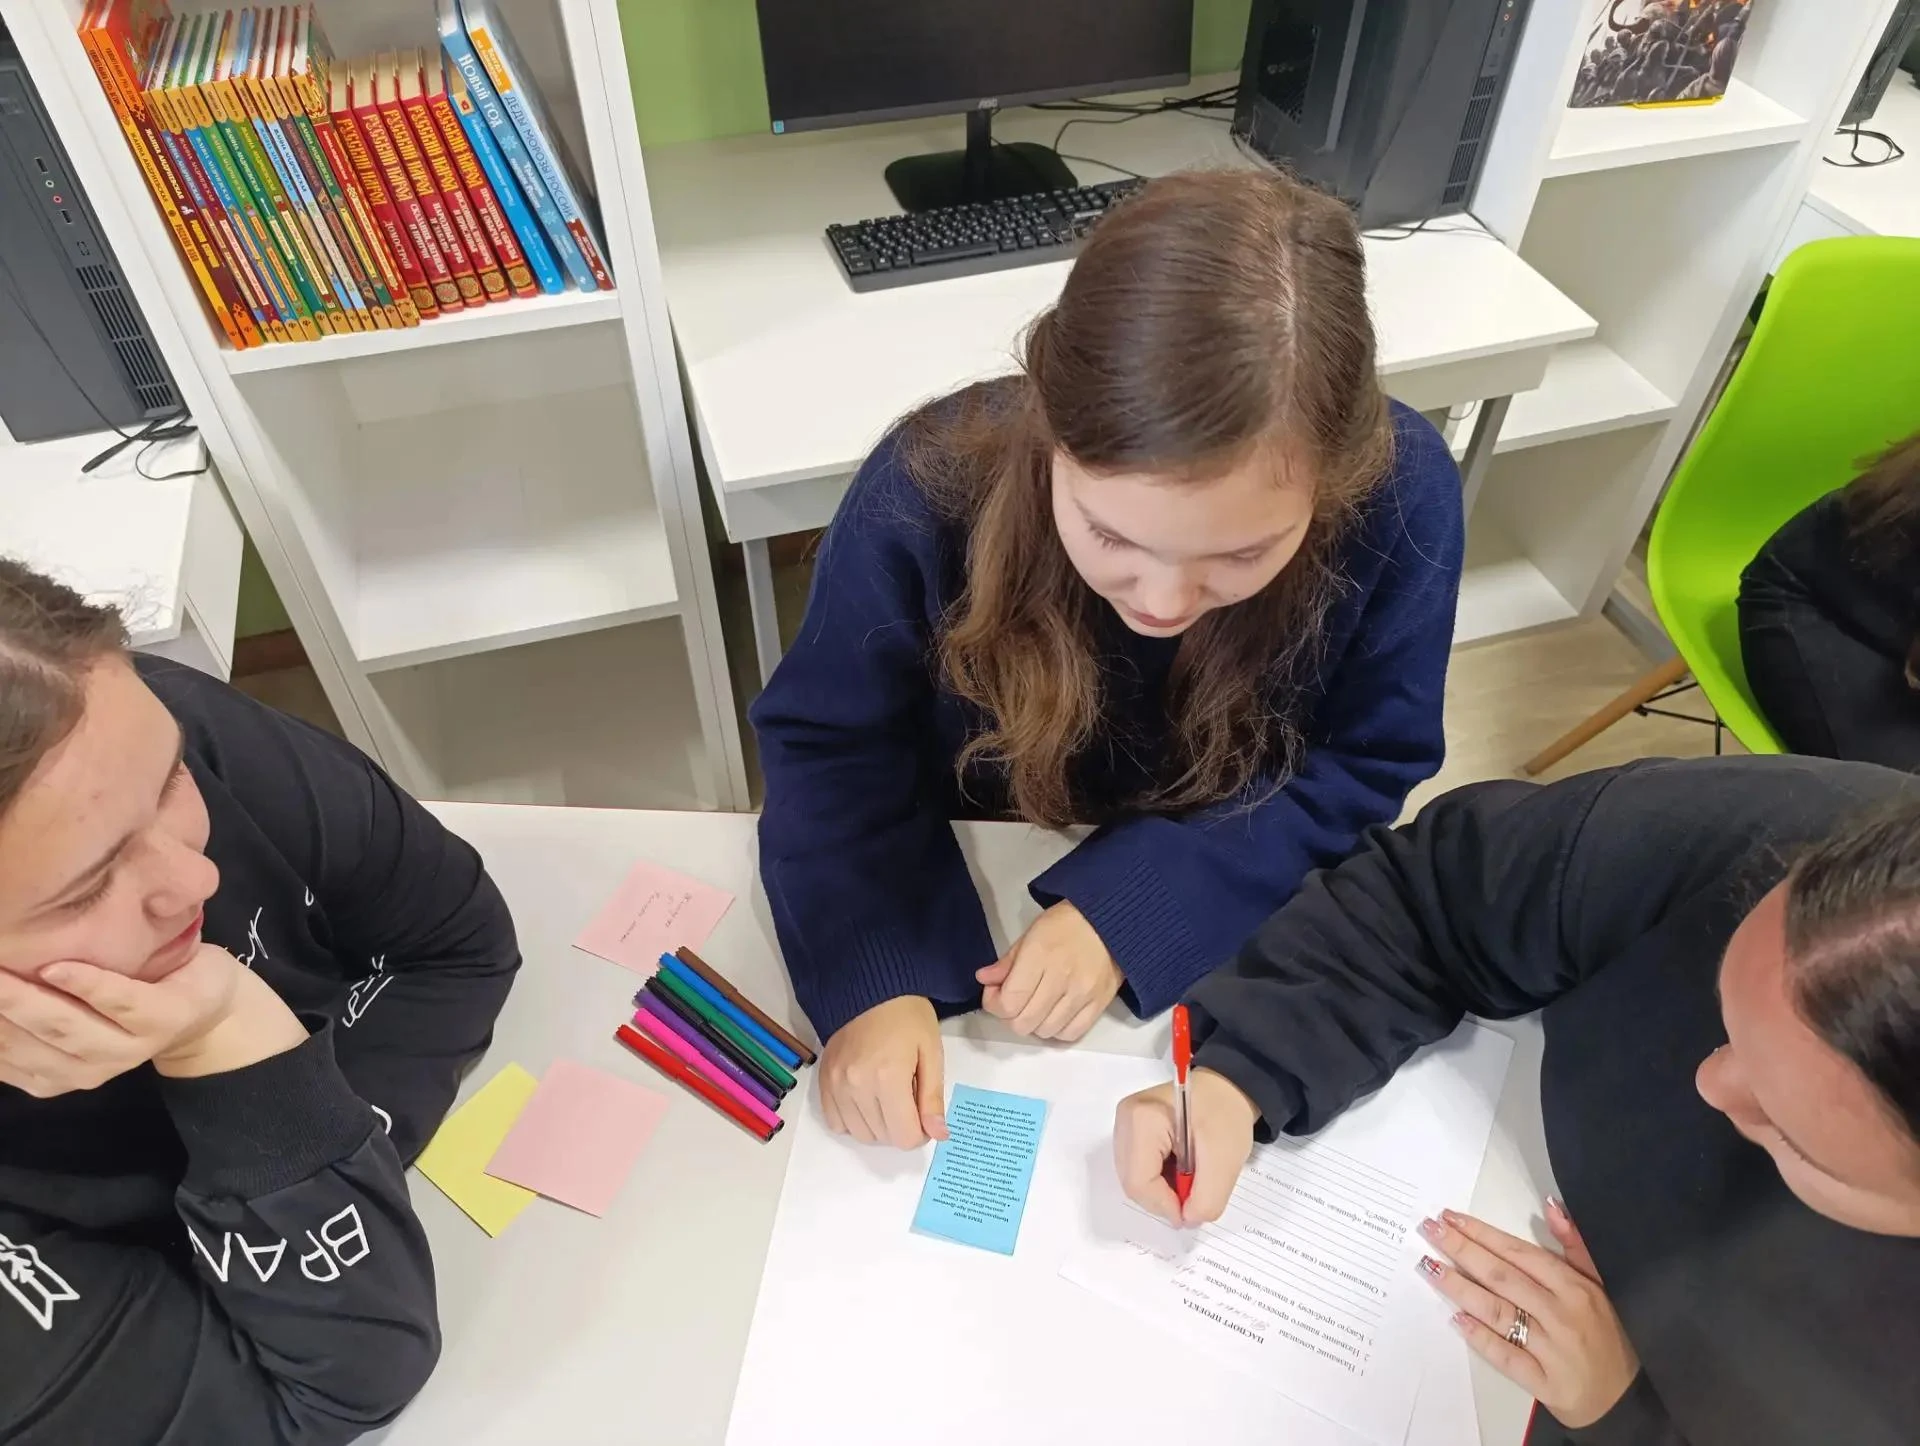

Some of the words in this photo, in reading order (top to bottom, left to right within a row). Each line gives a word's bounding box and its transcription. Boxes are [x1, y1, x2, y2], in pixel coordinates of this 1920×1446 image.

[335, 114, 374, 172] РУССКИЙ
[360, 110, 399, 168] РУССКИЙ
[382, 105, 421, 162] РУССКИЙ
[407, 102, 444, 158] РУССКИЙ
[432, 98, 469, 153] РУССКИЙ
[502, 92, 530, 129] ДЕДЫ
[520, 127, 554, 175] МОРОЗЫ
[544, 174, 575, 218] РОССИИ
[383, 218, 413, 270] ДОМОСТРОЙ
[1184, 1298, 1221, 1322] ПРОЕКТА
[1224, 1320, 1264, 1344] ПАСПОРТ
